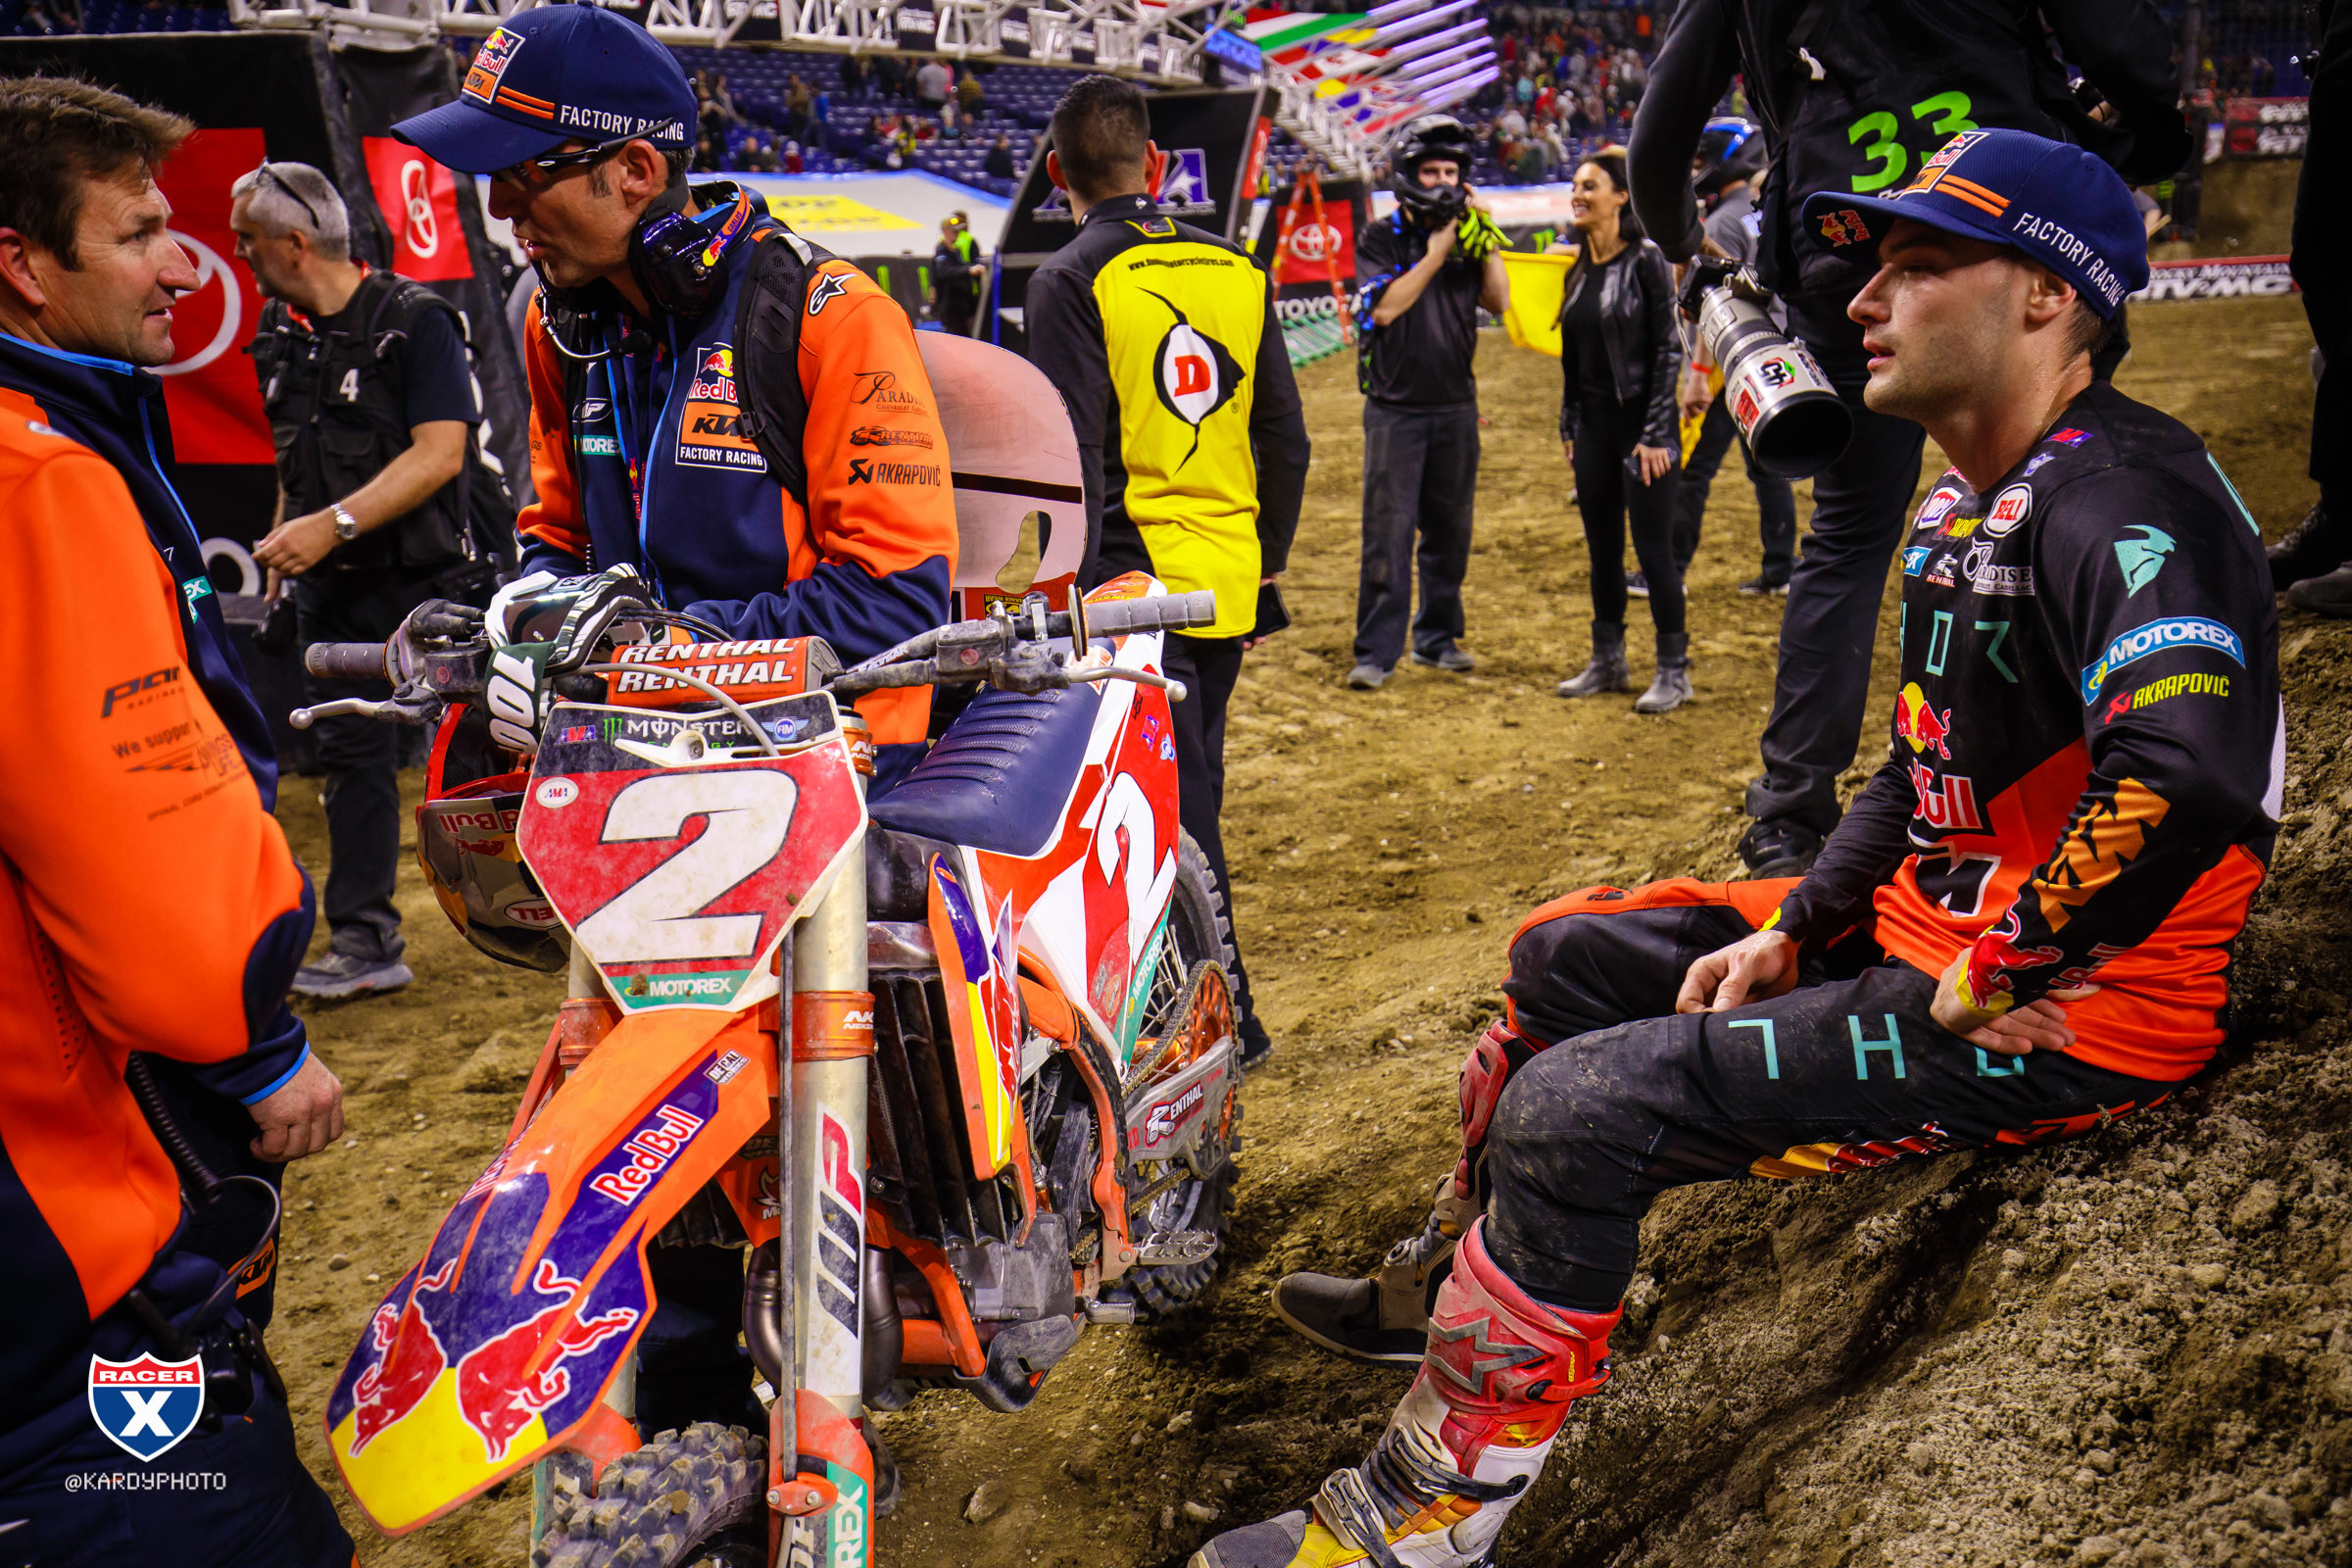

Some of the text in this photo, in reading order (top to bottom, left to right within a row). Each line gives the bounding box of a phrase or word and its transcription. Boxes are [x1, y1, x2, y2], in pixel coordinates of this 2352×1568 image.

[560, 104, 633, 135] FACTORY
[727, 211, 743, 232] CARLOS
[2012, 212, 2127, 308] FACTORY RACING
[1273, 294, 1362, 321] TOYOA
[339, 368, 360, 403] 4
[688, 376, 724, 400] Red
[1174, 355, 1211, 397] D
[679, 446, 763, 466] FACTORY RACING
[619, 638, 795, 663] RENTHAL
[2109, 621, 2238, 666] MOTOREX
[616, 660, 794, 693] RENTHAL
[554, 724, 599, 746] AMA
[627, 718, 754, 738] MONSTER
[776, 723, 794, 735] FIM
[111, 740, 142, 760] We
[544, 787, 568, 799] AMA
[438, 811, 500, 834] Bull
[575, 766, 800, 966] 2
[1097, 771, 1179, 966] 2
[510, 906, 556, 921] ELL
[1132, 928, 1165, 1001] MOTOREX
[649, 976, 732, 997] MOTOREX
[589, 1103, 705, 1206] Red Bull
